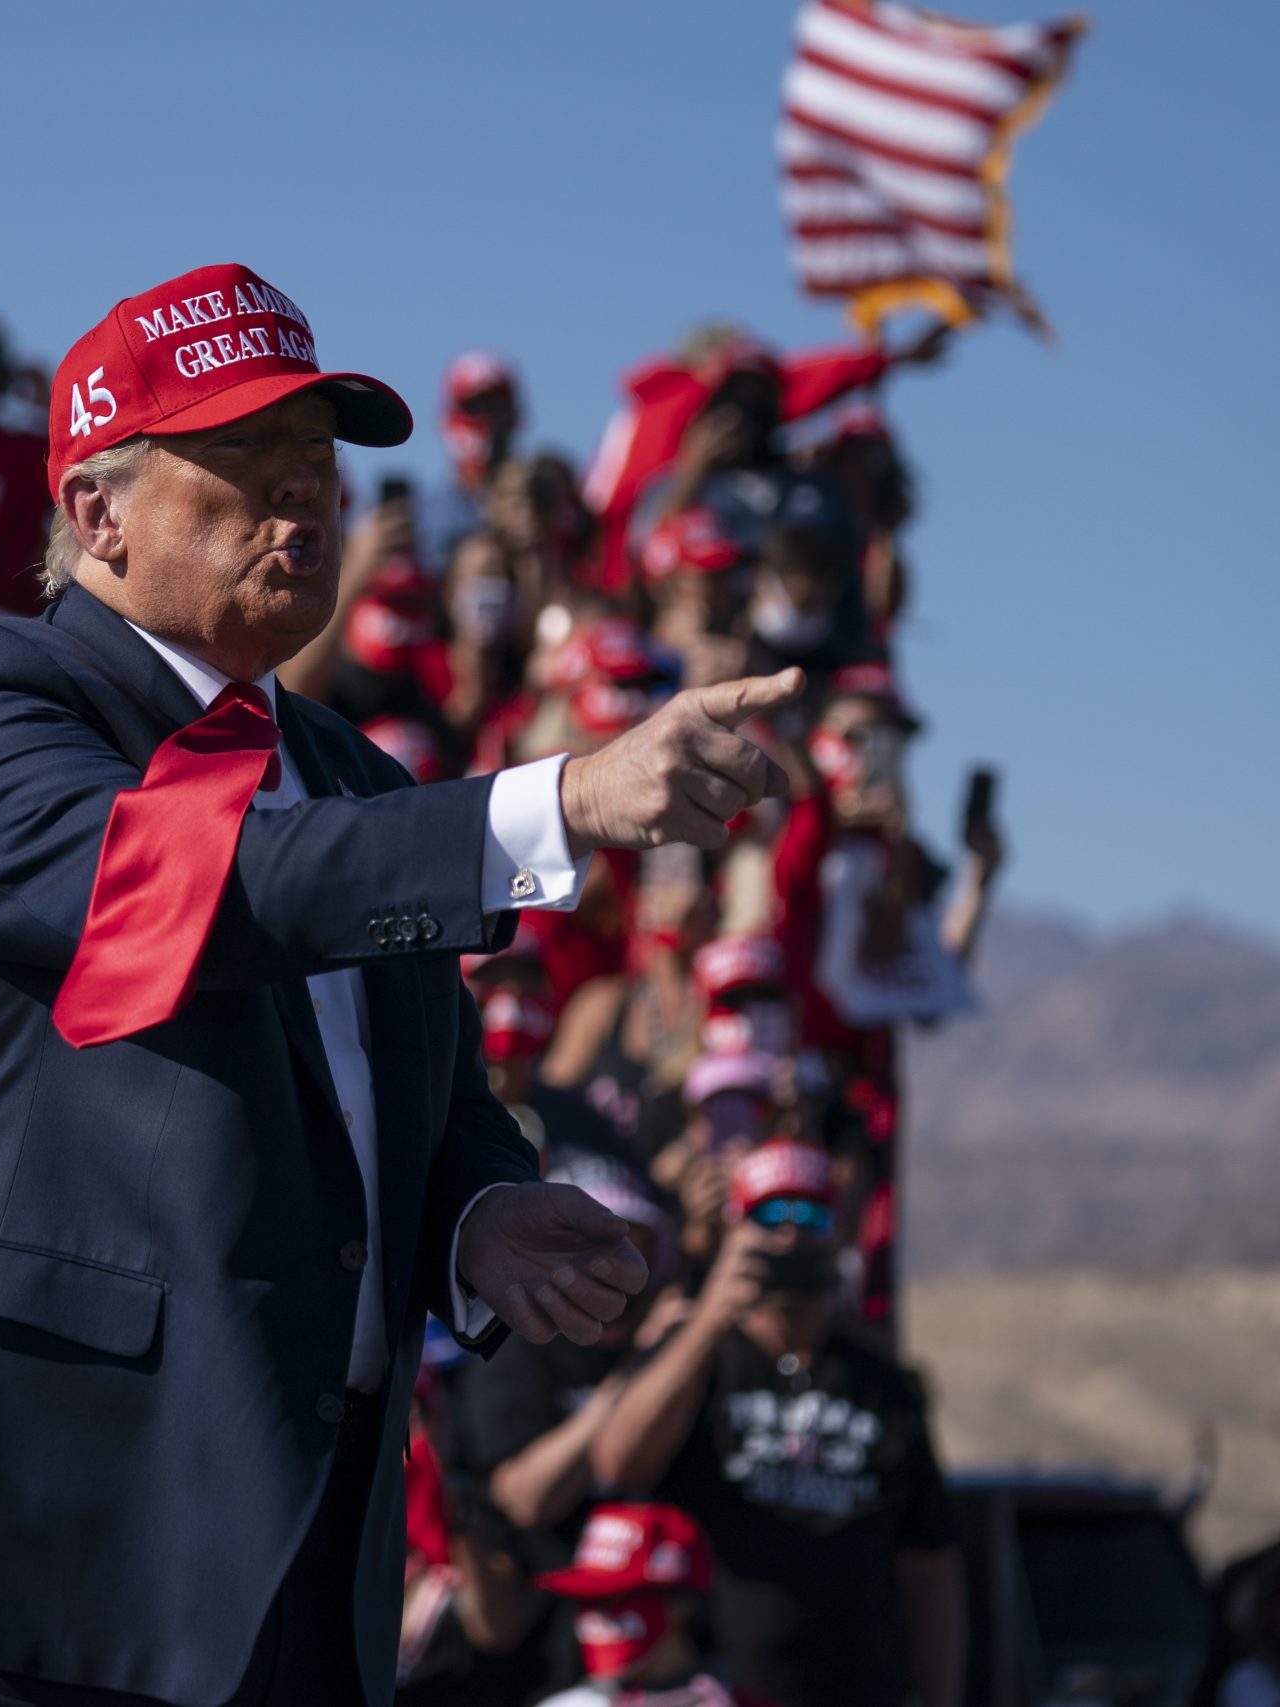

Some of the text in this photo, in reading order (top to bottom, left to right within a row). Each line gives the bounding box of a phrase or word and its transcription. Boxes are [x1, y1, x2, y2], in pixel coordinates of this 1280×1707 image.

[134, 290, 233, 343] MAKE
[175, 327, 275, 378] GREAT
[70, 365, 117, 437] 45
